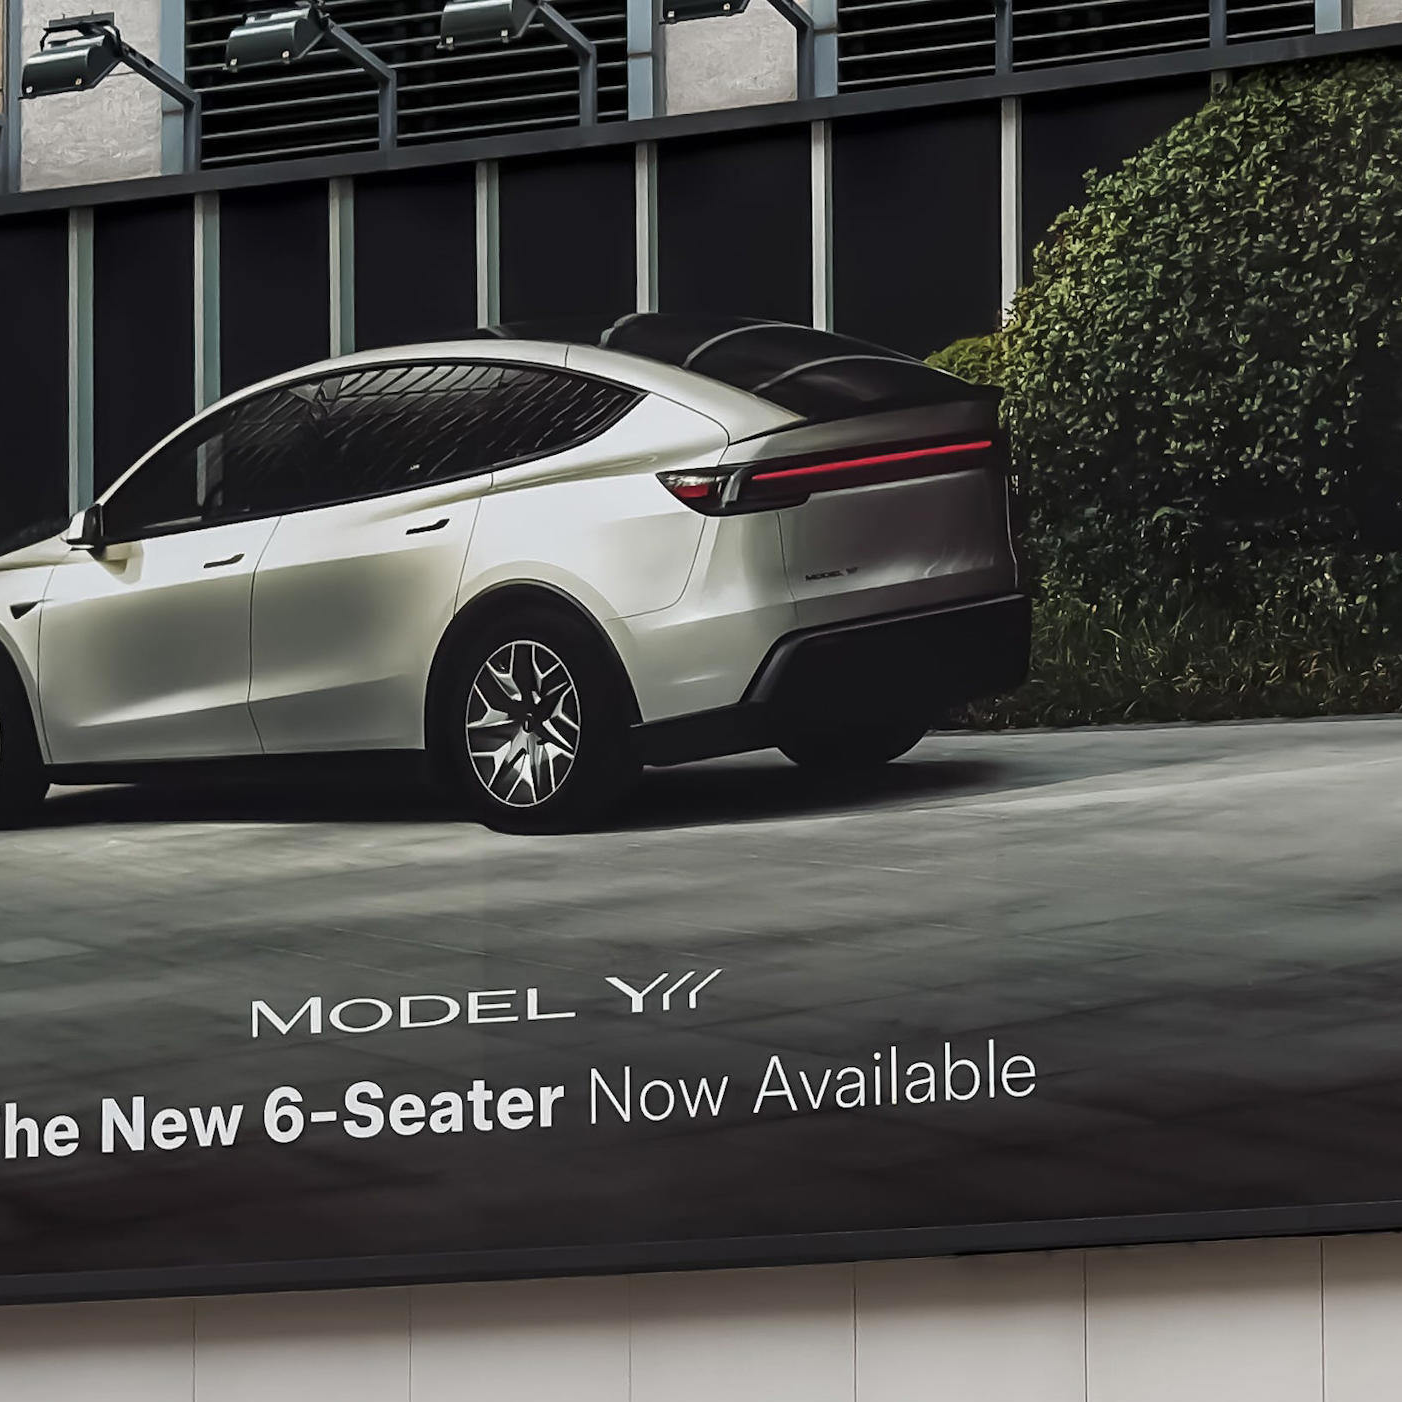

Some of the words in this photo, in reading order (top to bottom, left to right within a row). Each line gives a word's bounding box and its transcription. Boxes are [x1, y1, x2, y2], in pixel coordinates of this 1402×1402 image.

[251, 988, 577, 1038] MODEL
[101, 1096, 244, 1153] New
[263, 1080, 565, 1143] 6-Seater
[591, 1066, 729, 1125] Now
[752, 1038, 1037, 1114] Available
